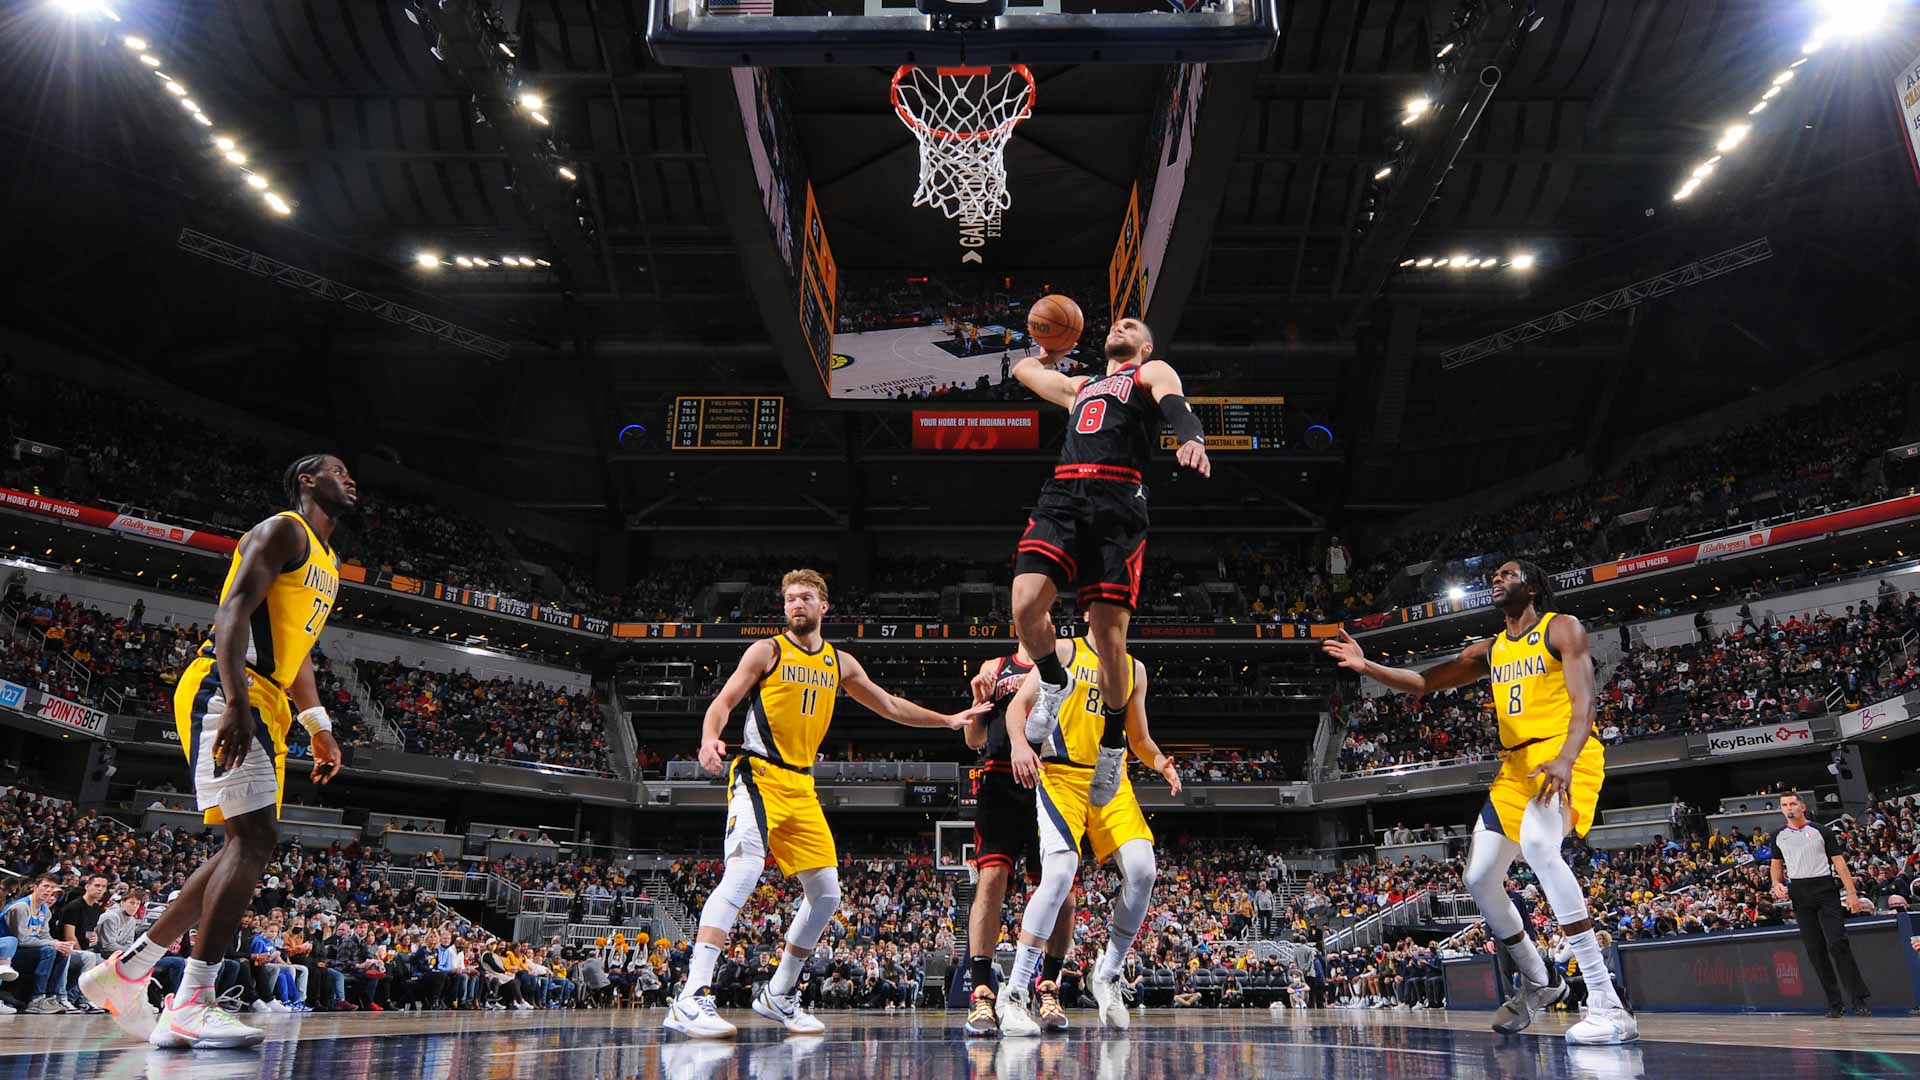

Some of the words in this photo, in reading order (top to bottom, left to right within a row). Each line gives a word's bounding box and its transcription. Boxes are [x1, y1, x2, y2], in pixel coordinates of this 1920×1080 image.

[1076, 398, 1107, 434] 8
[920, 418, 937, 427] YOUR
[938, 418, 957, 427] HOME
[958, 418, 966, 427] OF
[967, 418, 978, 427] THE
[979, 418, 1006, 427] INDIANA
[1007, 418, 1032, 427] PACERS
[7, 495, 28, 506] HOME
[29, 499, 38, 508] OF
[40, 501, 52, 511] THE
[53, 505, 80, 517] PACERS
[1637, 561, 1647, 569] THE
[1647, 556, 1669, 567] PACERS
[1560, 576, 1584, 588] 7/16
[446, 593, 457, 602] 31
[474, 598, 485, 608] 13
[1466, 595, 1492, 609] 19/49
[500, 604, 527, 617] 21/52
[1412, 611, 1423, 620] 27
[1438, 605, 1449, 614] 14
[543, 614, 569, 626] 11/14
[585, 623, 606, 633] 4/17
[652, 629, 658, 637] 4
[741, 626, 777, 635] INDIANA
[881, 625, 898, 636] 57
[969, 625, 998, 636] 8:07
[1060, 625, 1075, 637] 61
[1299, 629, 1306, 637] 5
[781, 664, 836, 690] INDIANA
[800, 687, 818, 716] 11
[1508, 682, 1523, 716] 8
[43, 697, 104, 731] POINTSBET
[1710, 733, 1775, 751] KeyBank
[913, 785, 937, 794] PACERS
